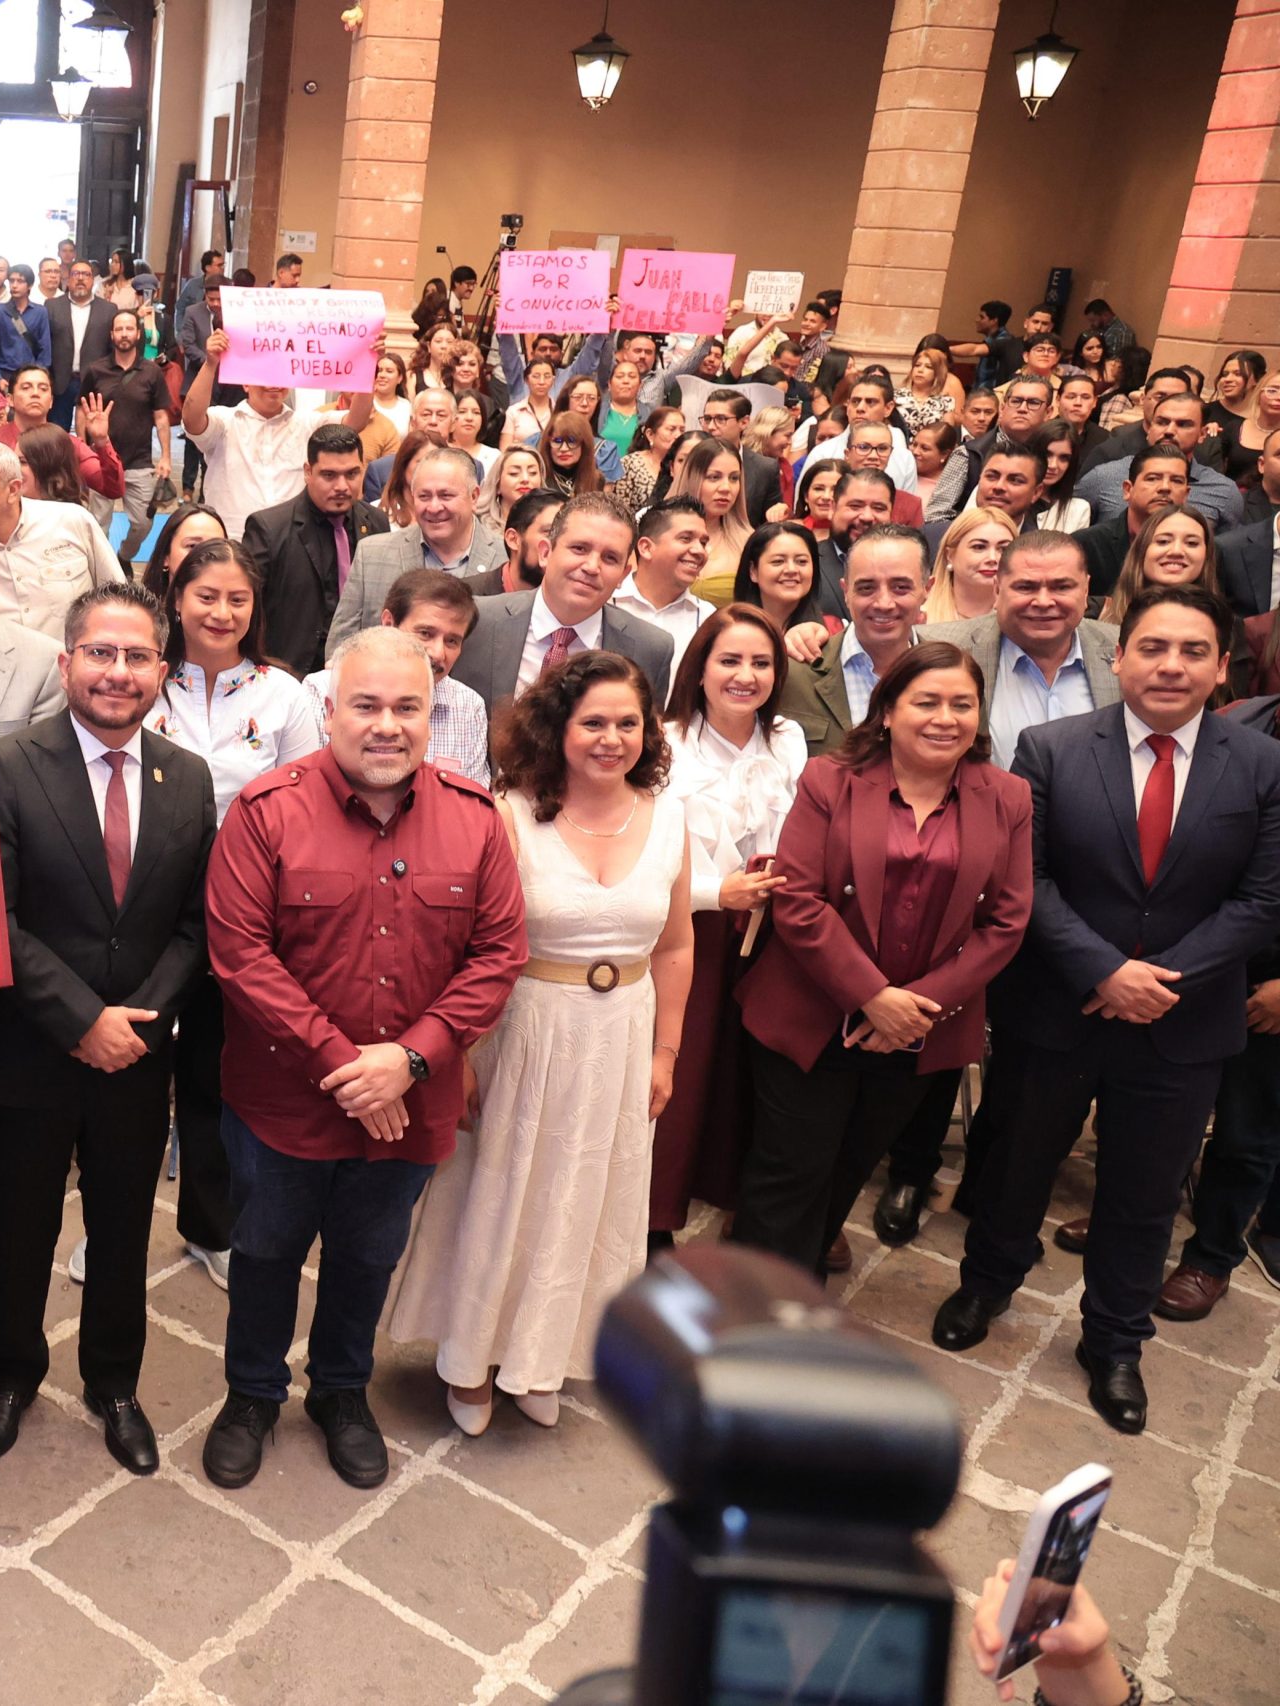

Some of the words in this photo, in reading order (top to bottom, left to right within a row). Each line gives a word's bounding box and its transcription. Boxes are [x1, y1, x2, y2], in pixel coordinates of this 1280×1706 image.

[507, 255, 588, 269] ESTAMOS
[632, 258, 682, 289] JUAN
[256, 321, 287, 333] MAS
[297, 322, 368, 338] SAGRADO
[253, 338, 296, 352] PARA
[307, 340, 326, 354] EL
[291, 358, 353, 376] PUEBLO
